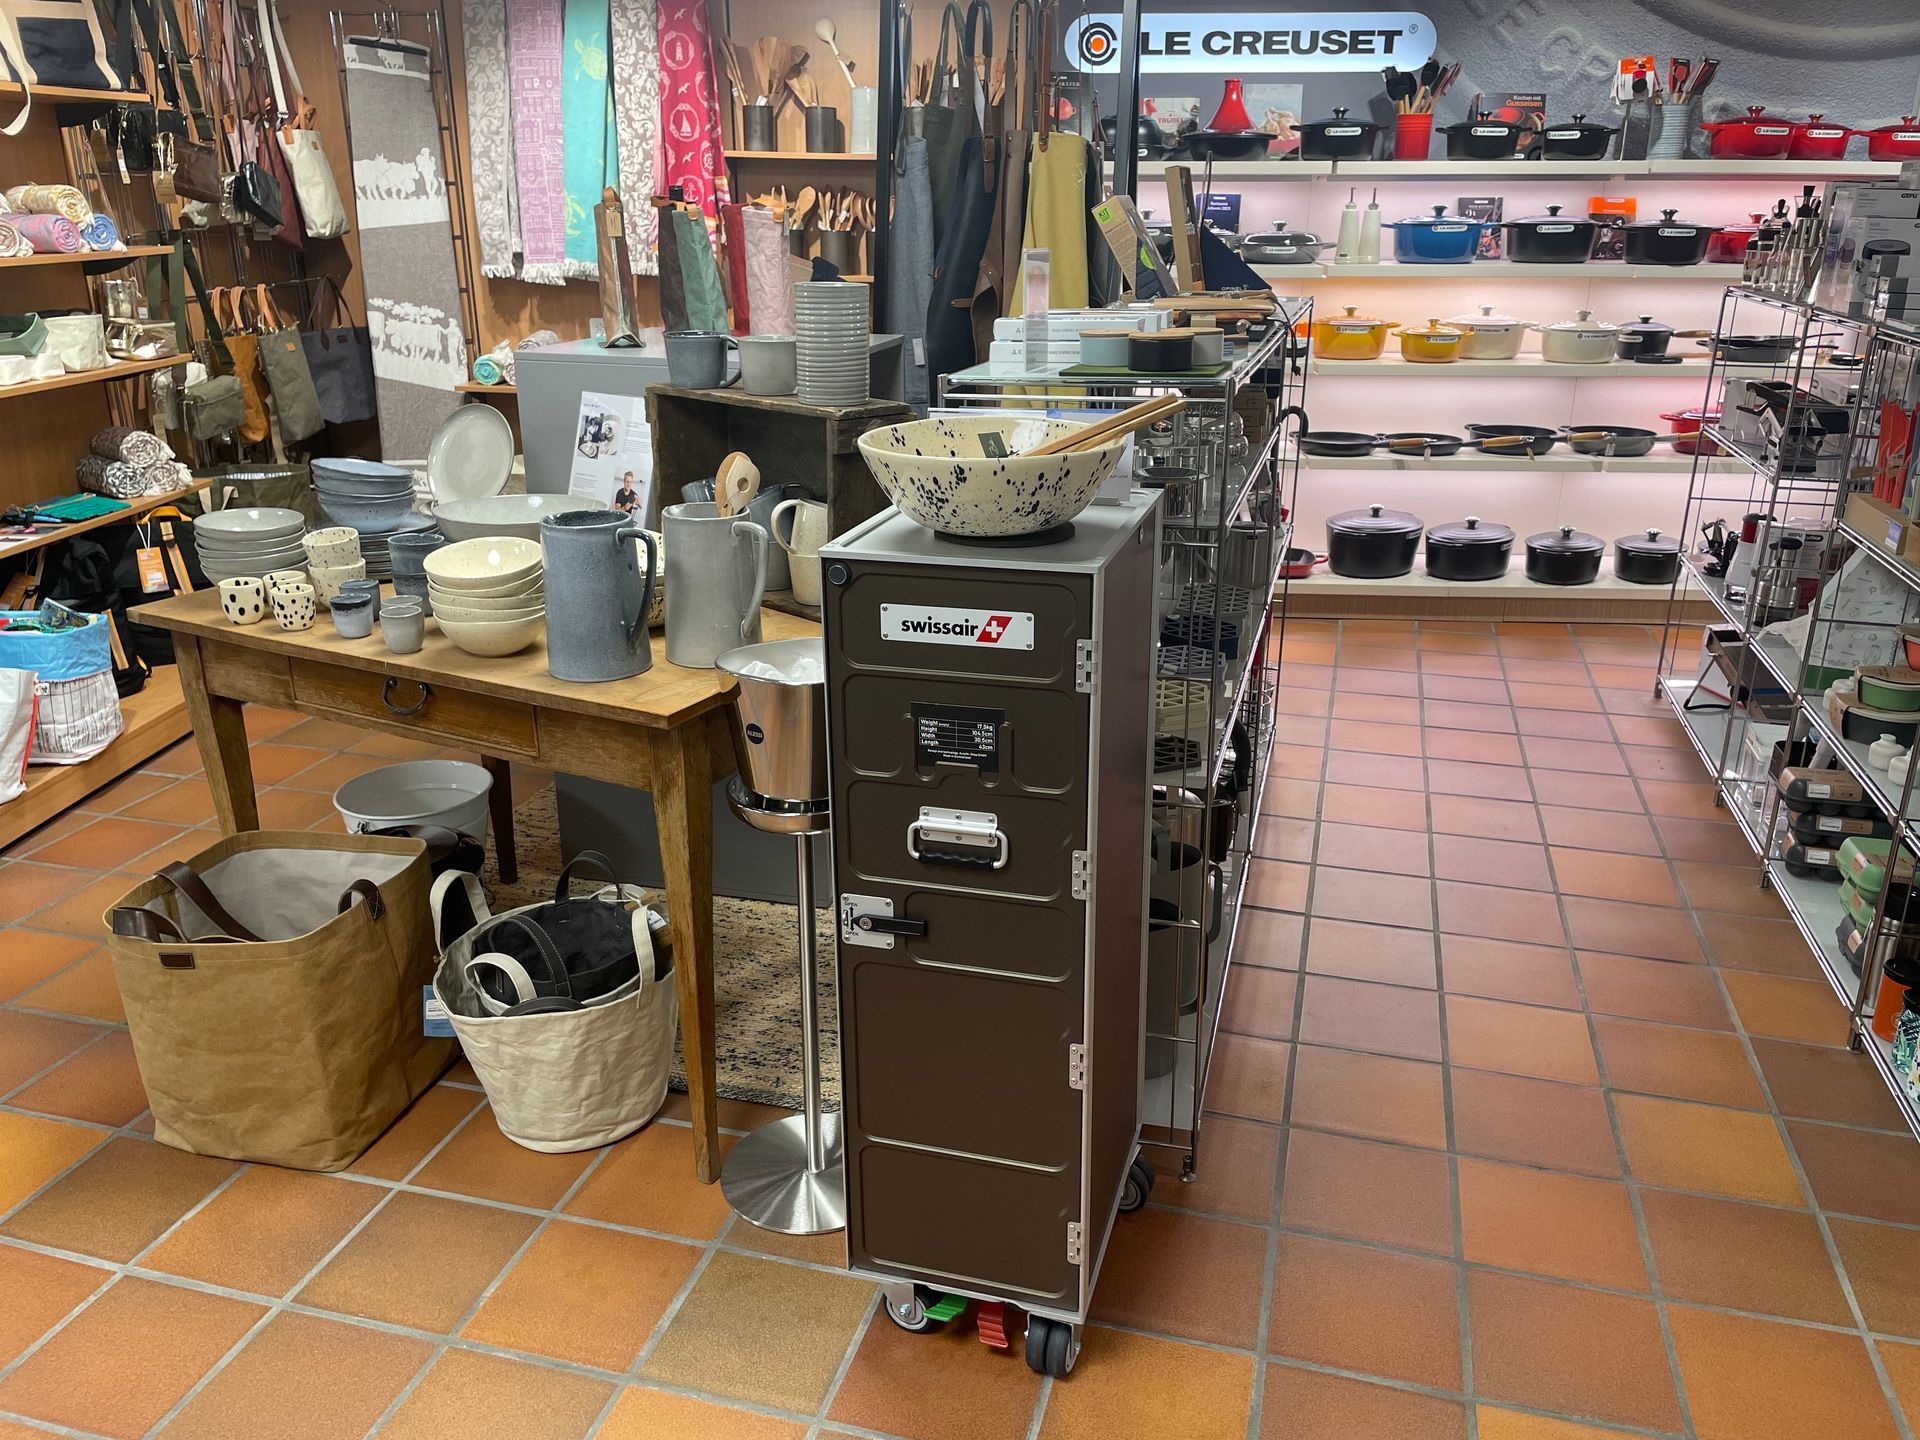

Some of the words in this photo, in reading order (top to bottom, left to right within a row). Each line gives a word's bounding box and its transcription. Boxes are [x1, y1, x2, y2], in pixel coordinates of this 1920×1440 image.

[1140, 32, 1191, 56] LE
[1202, 30, 1402, 56] CREUSET
[1098, 208, 1108, 218] KIT
[901, 616, 978, 636] swissair
